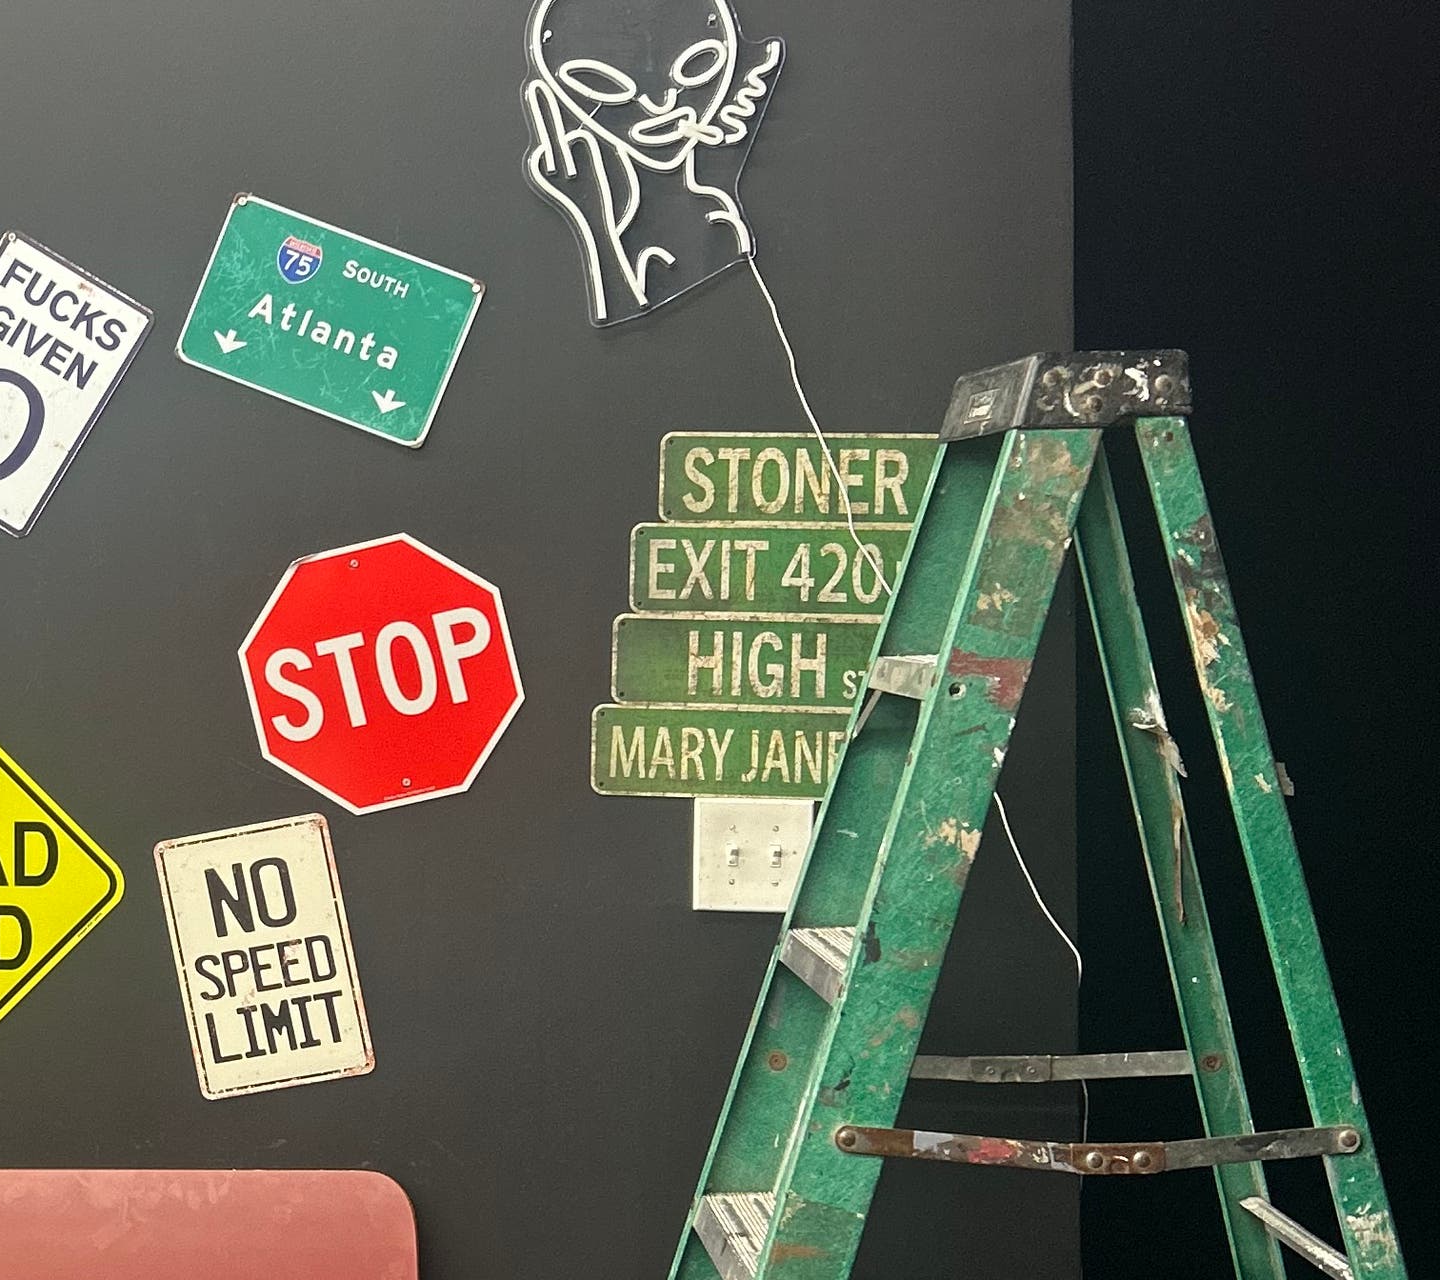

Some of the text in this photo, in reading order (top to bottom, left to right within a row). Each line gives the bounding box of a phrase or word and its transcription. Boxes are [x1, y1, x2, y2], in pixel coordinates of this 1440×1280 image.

[284, 248, 410, 299] 75 SOUTH
[247, 293, 400, 370] Atlanta
[681, 446, 910, 516] STONER
[647, 538, 885, 605] EXIT 420
[263, 606, 492, 743] STOP
[687, 629, 867, 700] HIGH S
[608, 724, 735, 782] MARY
[203, 856, 298, 938] NO
[193, 934, 338, 1002] SPEED
[204, 989, 344, 1065] LIMIT
